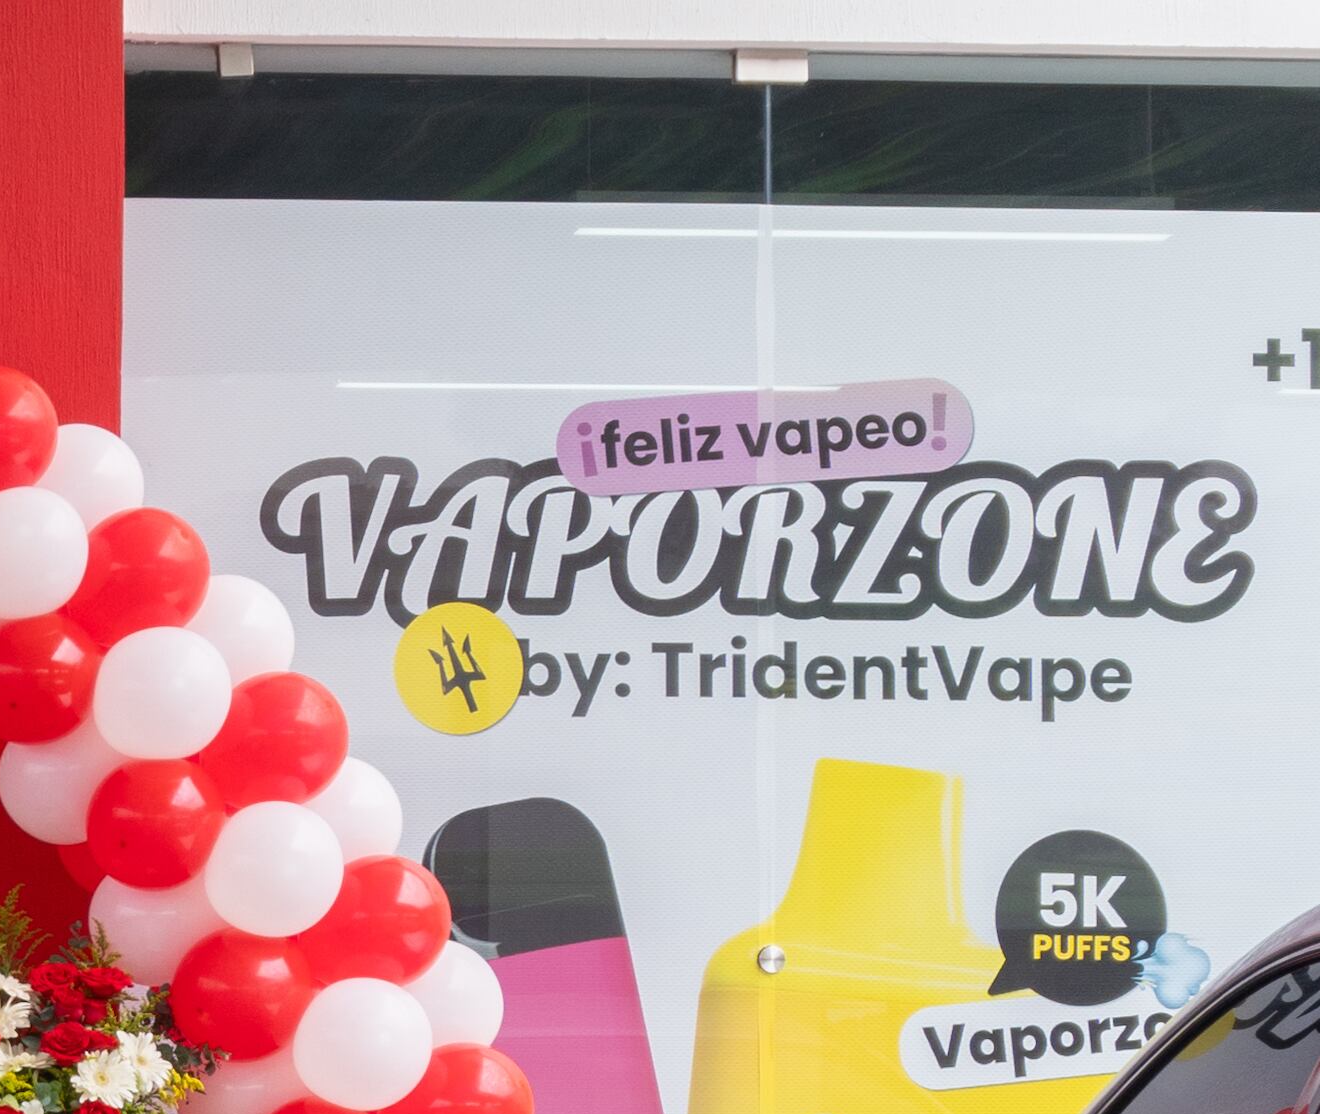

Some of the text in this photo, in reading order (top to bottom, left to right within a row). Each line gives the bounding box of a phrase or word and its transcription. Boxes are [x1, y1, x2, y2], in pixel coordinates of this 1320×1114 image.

[577, 392, 949, 478] ¡feliz vapeo!
[261, 457, 1257, 624] VAPORZONE
[518, 637, 1134, 724] by: TridentVape
[1038, 871, 1128, 928] 5K
[1032, 934, 1131, 962] PUFFS
